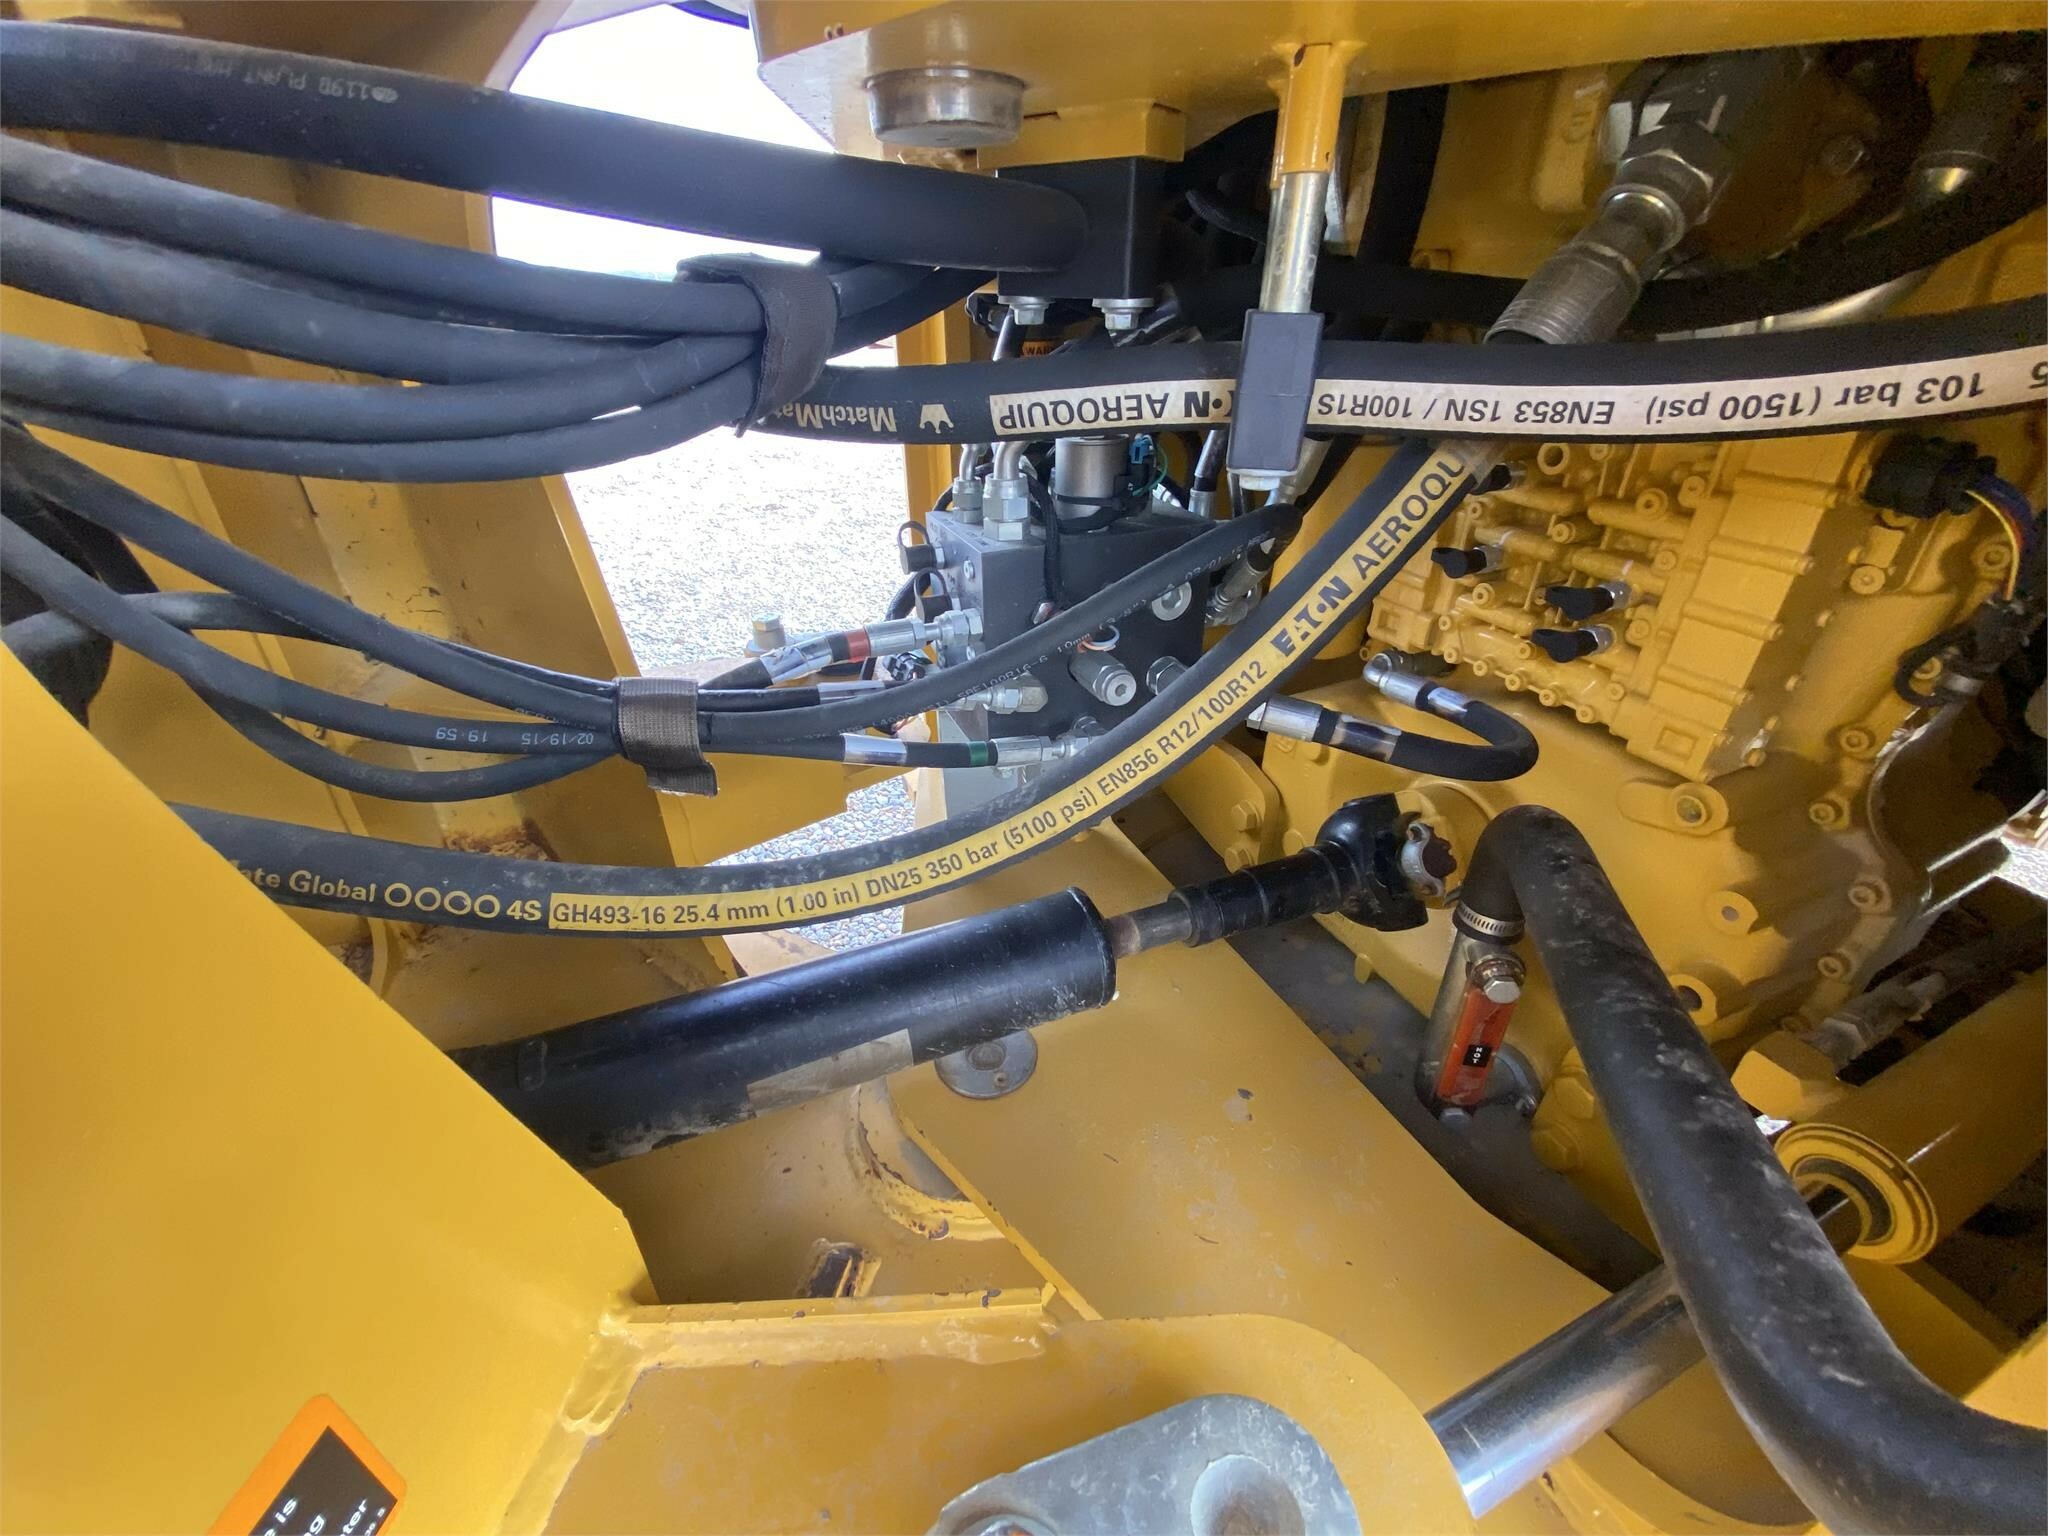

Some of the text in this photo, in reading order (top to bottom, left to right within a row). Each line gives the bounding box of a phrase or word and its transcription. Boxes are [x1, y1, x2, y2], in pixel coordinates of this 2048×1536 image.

[1720, 385, 1822, 420] (1500
[1835, 381, 1901, 411] bar
[1916, 371, 1986, 405] 103
[999, 393, 1170, 430] AEROQUIP
[1317, 393, 1414, 419] 100R1S
[1445, 398, 1501, 421] 1SN
[1514, 398, 1615, 424] EN853
[1645, 391, 1709, 424] psi)
[522, 731, 595, 746] 02/19/15
[552, 902, 666, 926] GH493-16
[673, 902, 719, 924] 25.4
[726, 903, 771, 921] mm
[776, 890, 829, 917] (1.00
[833, 881, 861, 906] in)
[866, 868, 924, 898] DN25
[928, 853, 963, 880] 350
[966, 838, 1001, 865] bar
[1003, 810, 1058, 851] (5100
[1061, 787, 1098, 823] psi)
[1097, 748, 1160, 797] EN856
[1157, 659, 1268, 756] R12/100R12
[290, 869, 377, 902] Global
[506, 899, 542, 921] 4S
